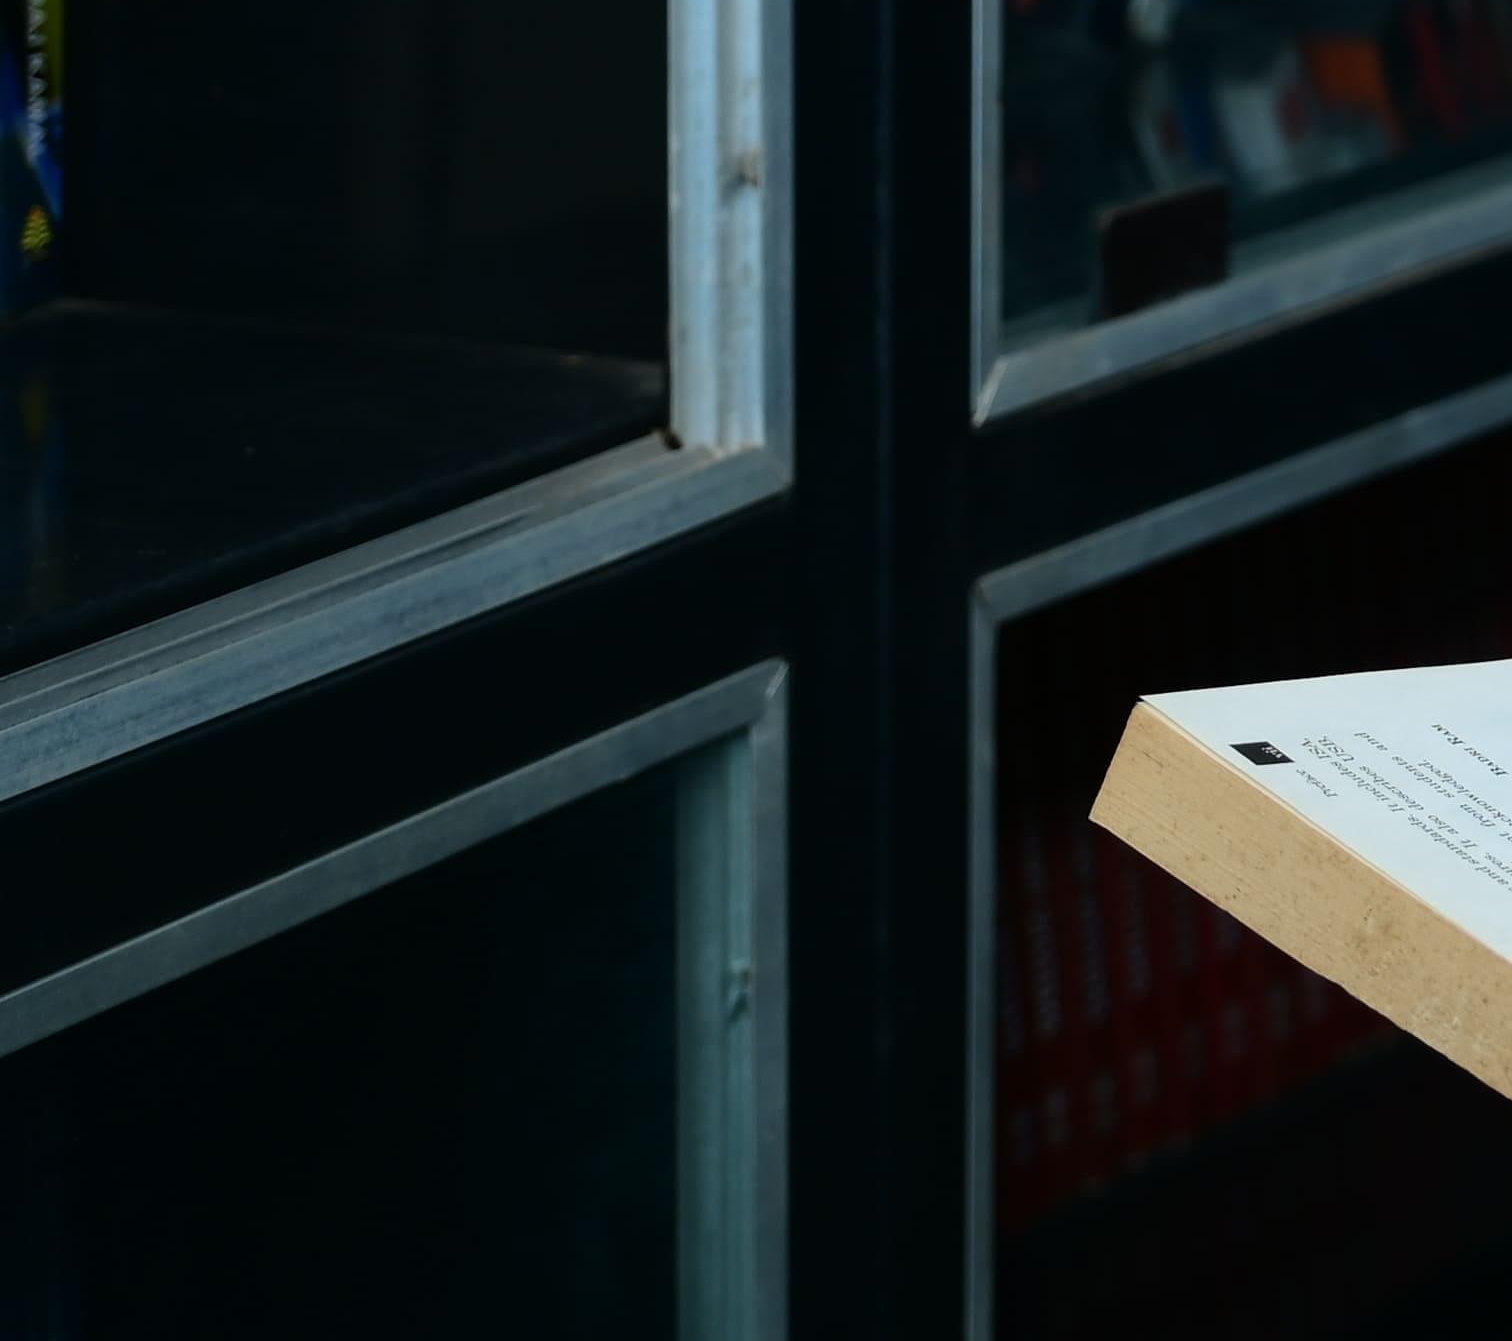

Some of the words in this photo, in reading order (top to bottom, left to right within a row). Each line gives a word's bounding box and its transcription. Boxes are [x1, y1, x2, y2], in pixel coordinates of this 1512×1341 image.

[1260, 745, 1283, 759] vii
[1353, 732, 1389, 751] and
[1330, 761, 1390, 802] includes
[1359, 765, 1425, 811] describes
[1391, 756, 1456, 799] students
[1387, 803, 1405, 813] It
[1459, 803, 1497, 828] from
[1427, 814, 1459, 835] also
[1407, 814, 1480, 865] standards.
[1460, 839, 1478, 849] It
[1474, 866, 1509, 885] and
